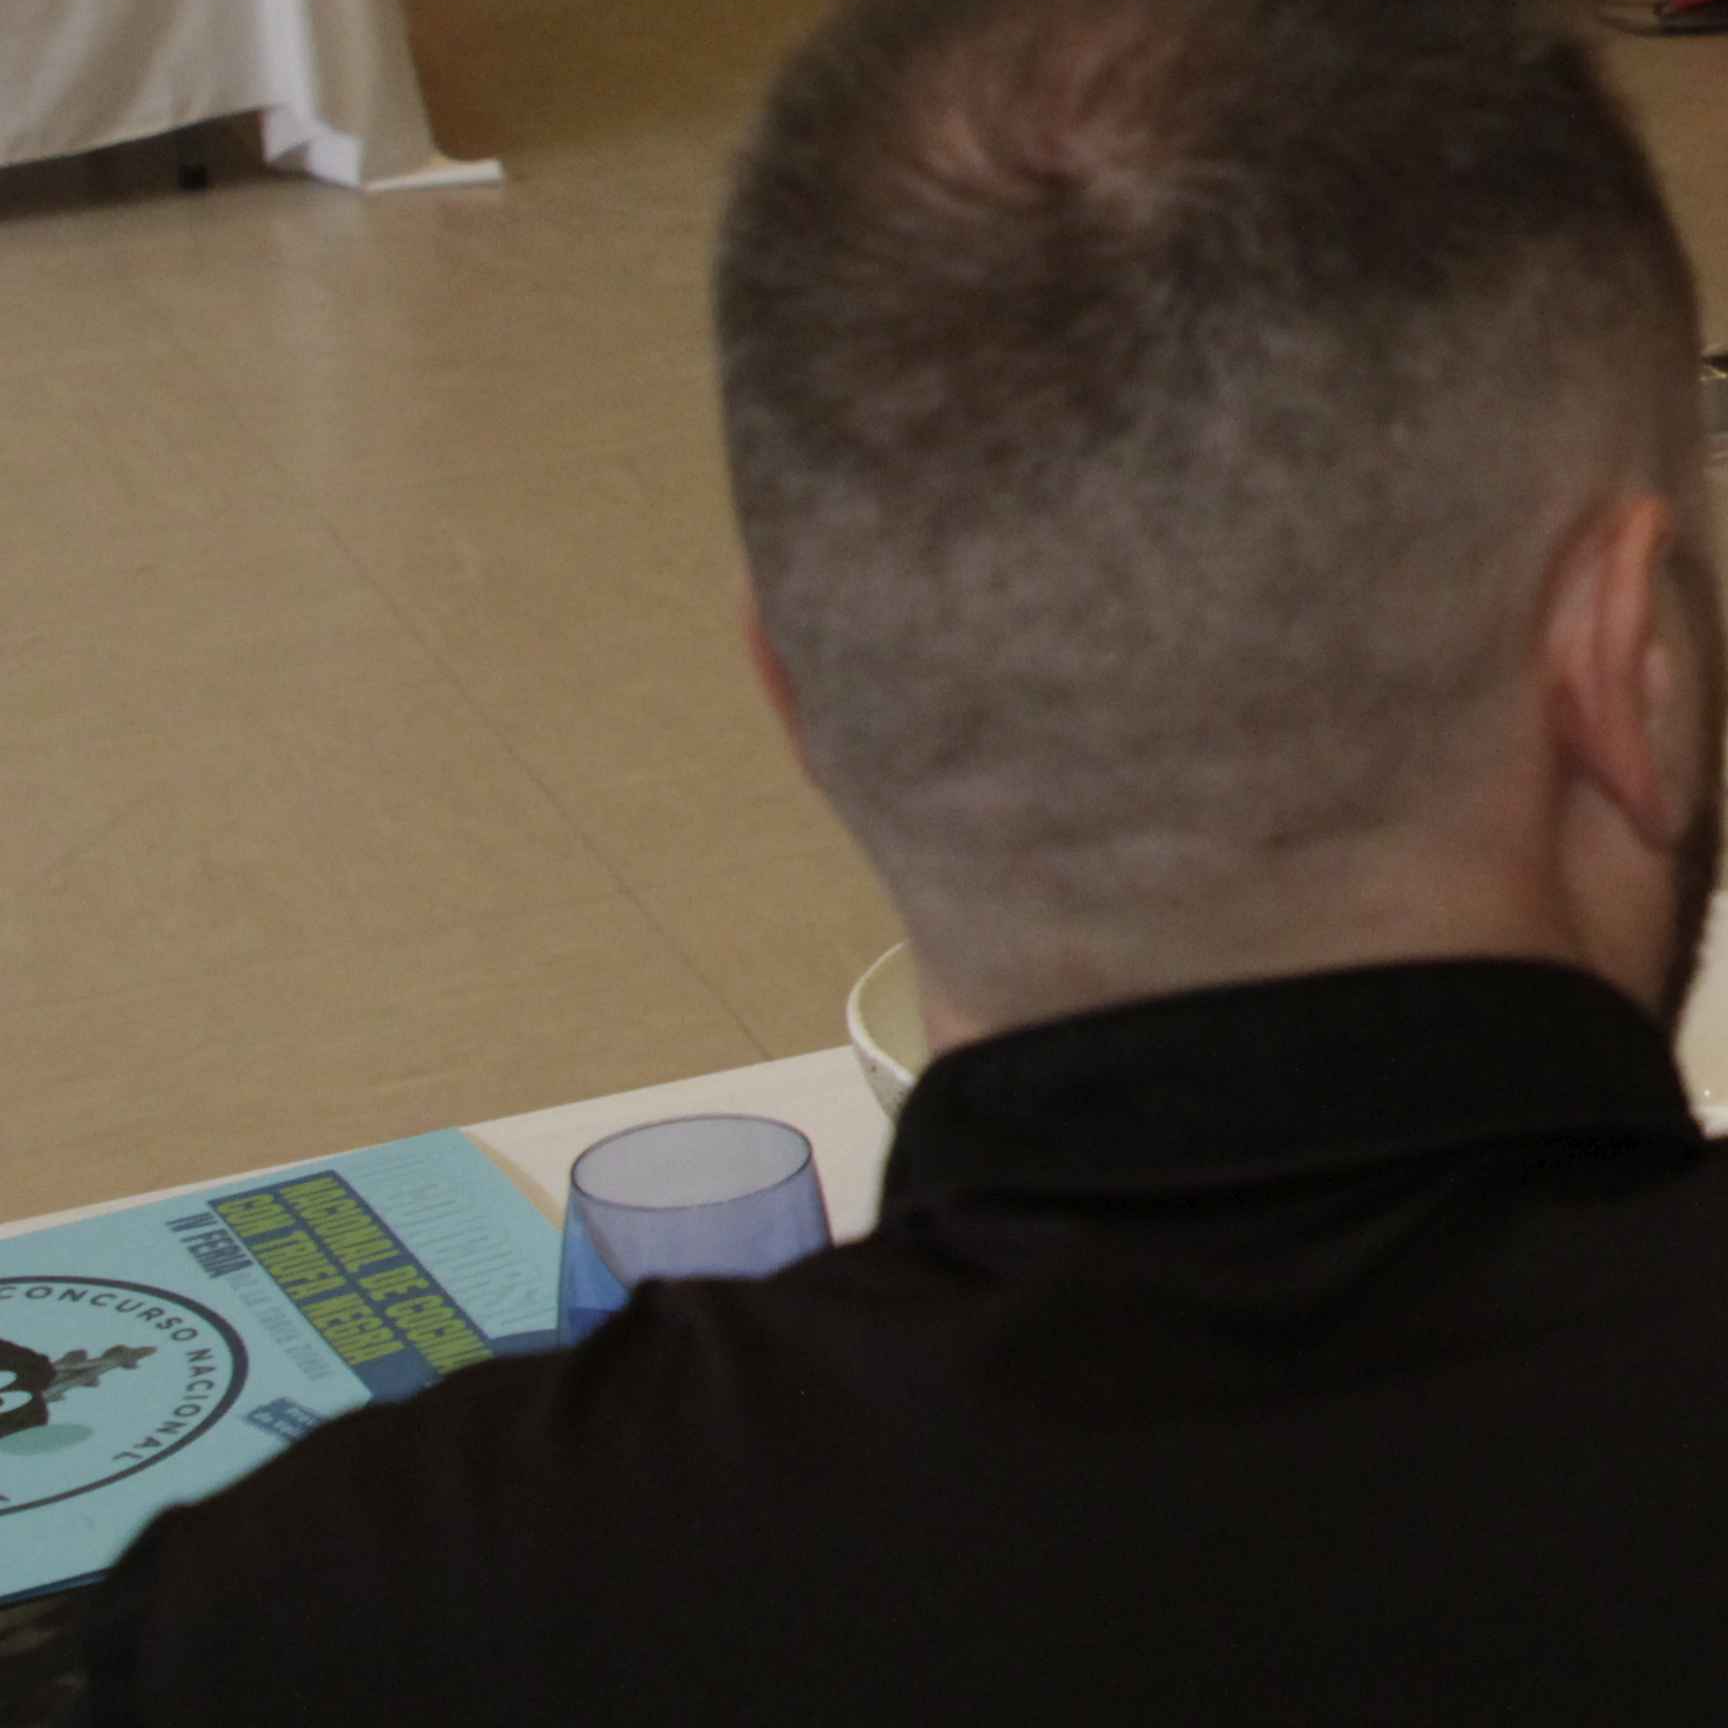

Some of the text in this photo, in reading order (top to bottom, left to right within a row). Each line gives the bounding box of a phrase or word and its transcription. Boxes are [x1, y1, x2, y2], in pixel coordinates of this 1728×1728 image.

[164, 1210, 221, 1233] IV
[217, 1193, 296, 1238] CON
[279, 1175, 402, 1272] NACIONAL
[357, 1265, 430, 1301] DE
[180, 1227, 255, 1280] FERIA
[251, 1233, 345, 1302] TRUFA
[301, 1290, 408, 1367] NEGRA
[112, 1346, 217, 1463] NACIONAL
